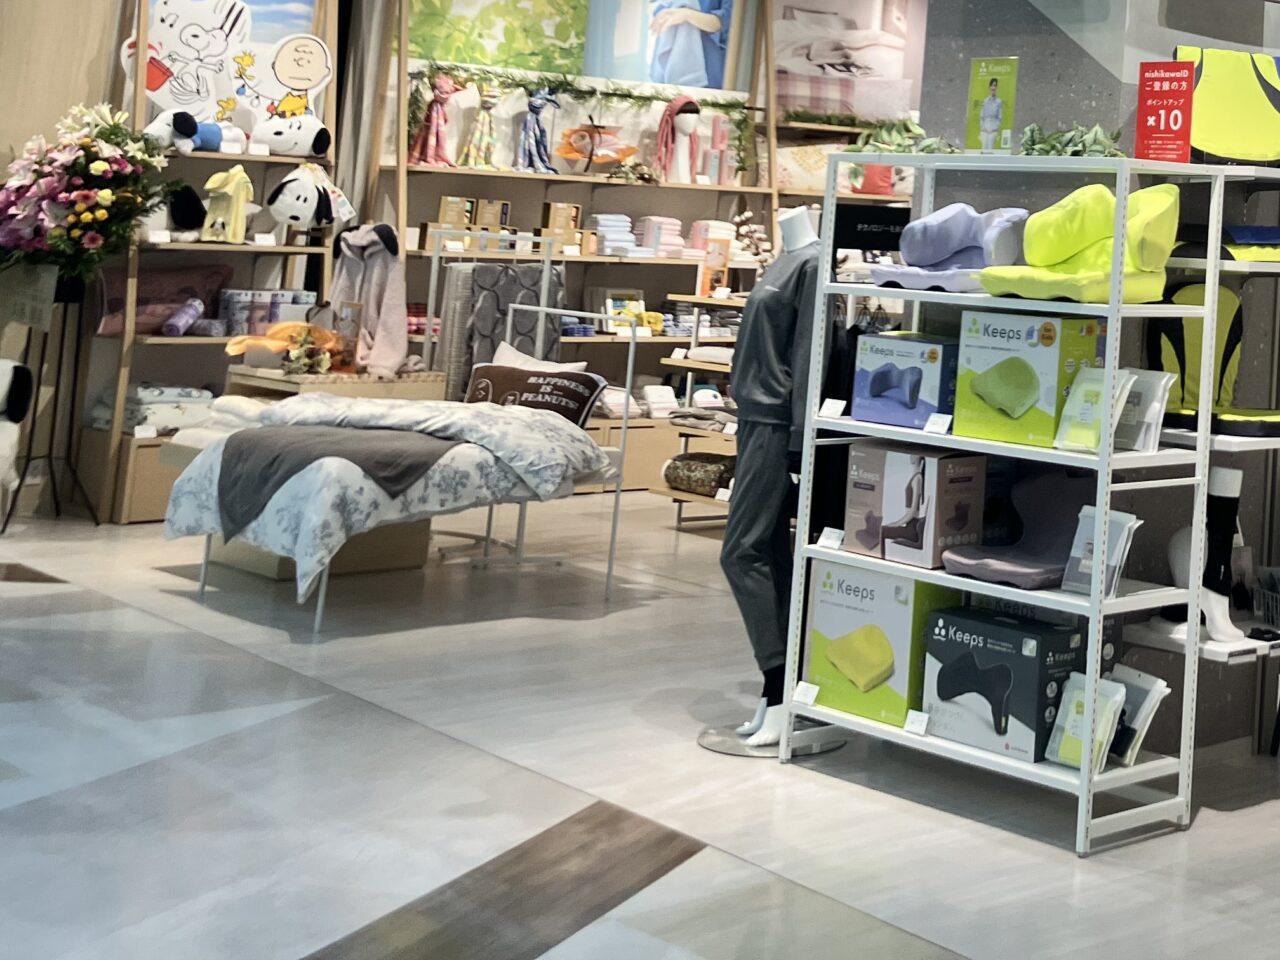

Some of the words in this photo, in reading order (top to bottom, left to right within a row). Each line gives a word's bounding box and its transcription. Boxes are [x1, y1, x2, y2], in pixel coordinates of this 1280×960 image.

[1144, 69, 1189, 78] nishikawaID
[1145, 81, 1188, 91] ご登録の方
[1146, 98, 1185, 106] ポイントアップ
[982, 323, 1022, 343] Keeps
[869, 344, 894, 358] Keeps
[858, 468, 880, 482] Keeps
[836, 578, 876, 603] Keeps
[948, 625, 985, 649] Keeps
